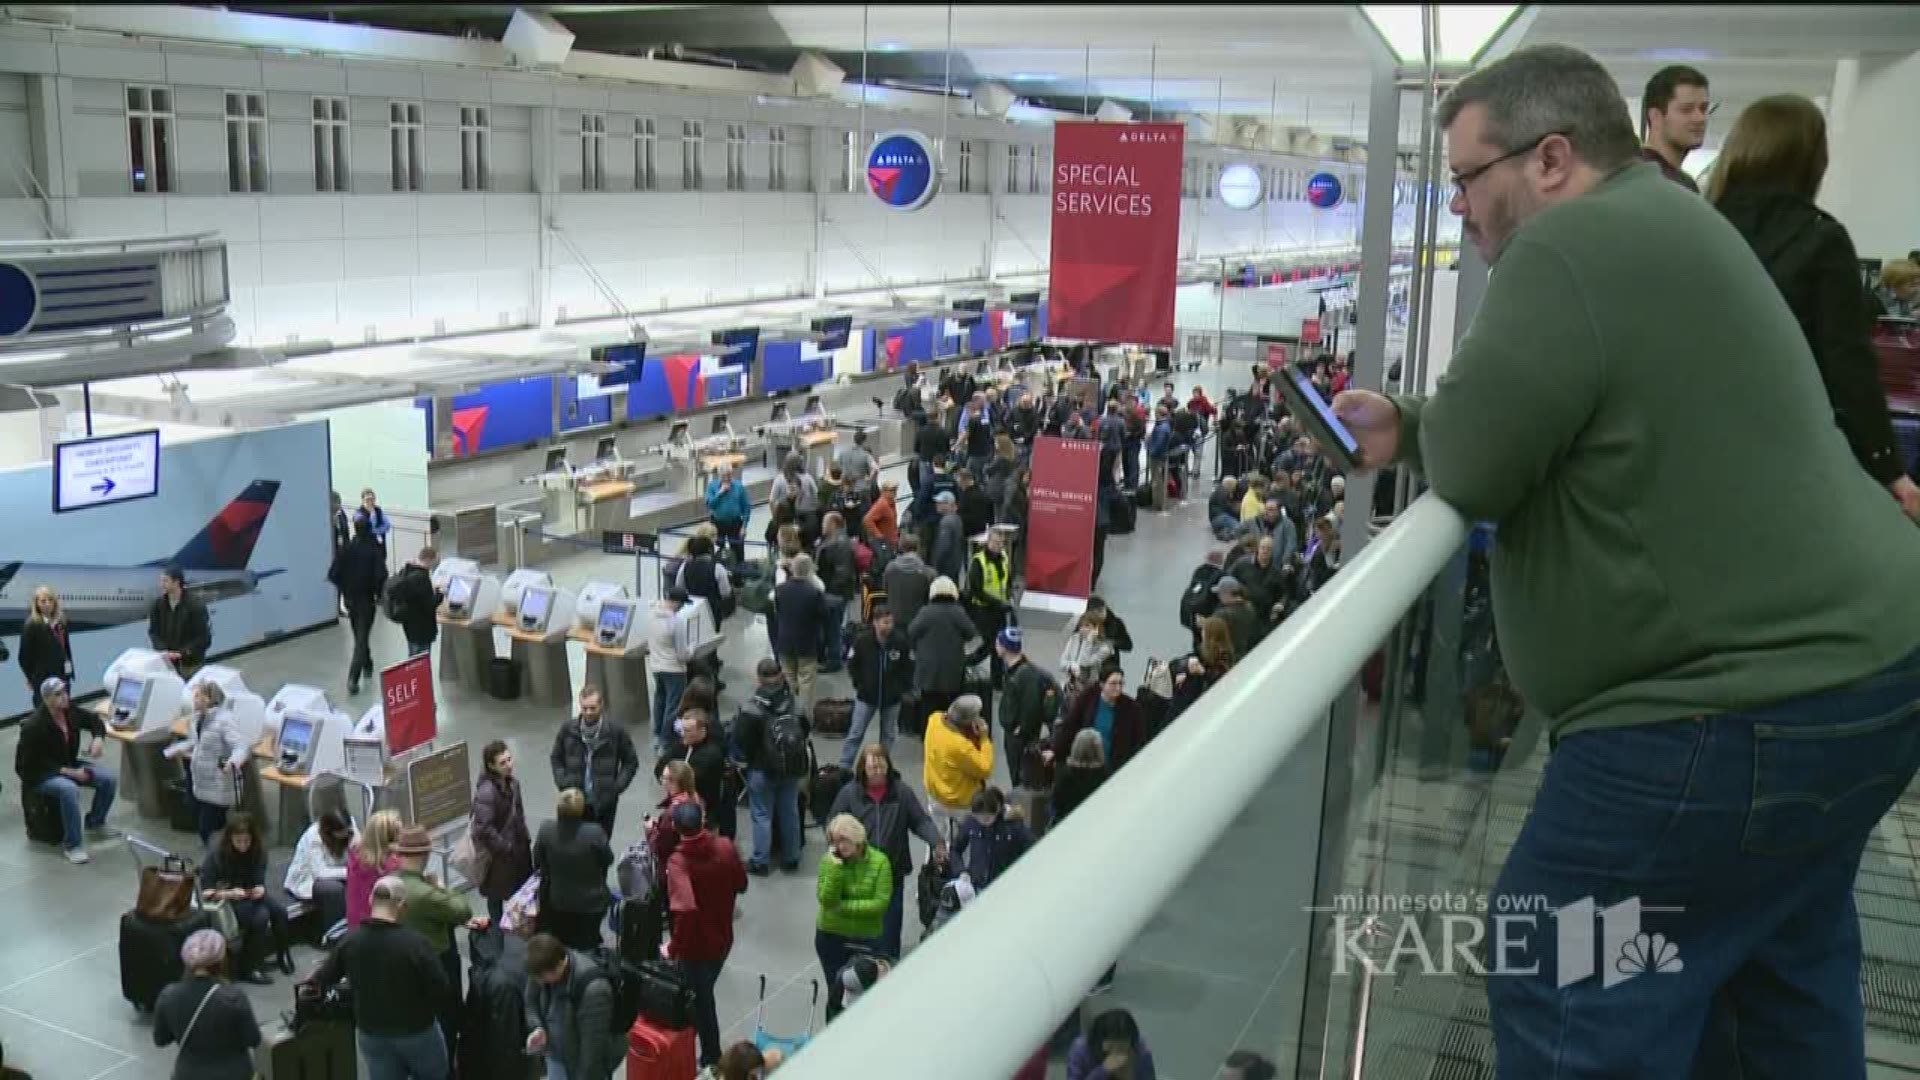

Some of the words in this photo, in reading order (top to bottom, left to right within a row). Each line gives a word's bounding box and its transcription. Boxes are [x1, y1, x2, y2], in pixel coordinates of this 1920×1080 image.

[1131, 132, 1166, 142] DELTA
[886, 155, 915, 164] DELTA
[1058, 164, 1141, 186] SPECIAL
[1056, 192, 1152, 216] SERVICES
[386, 678, 418, 707] SELF
